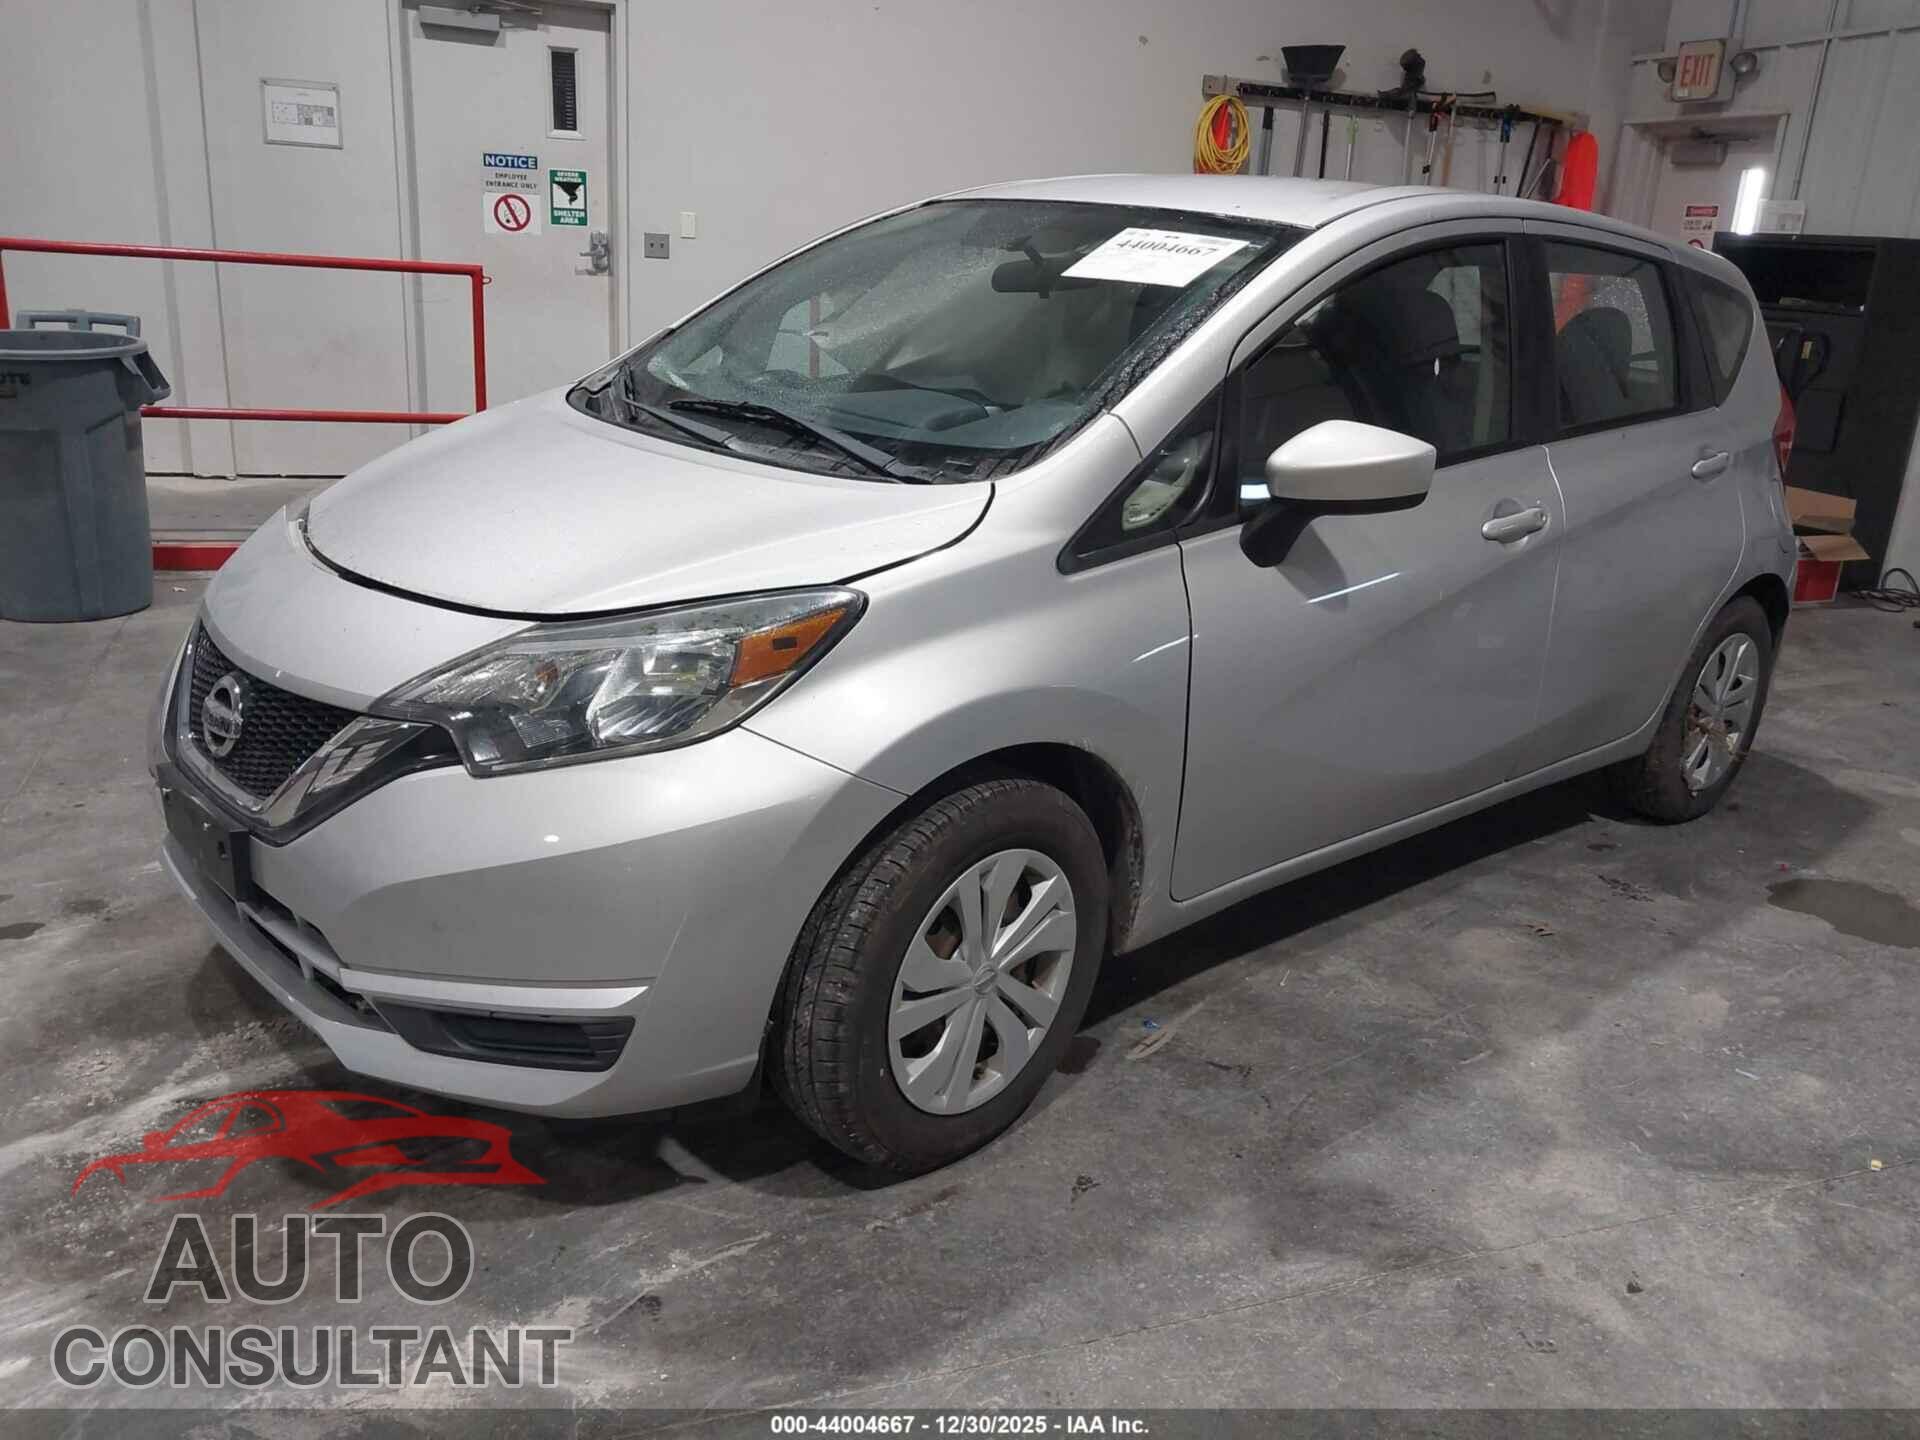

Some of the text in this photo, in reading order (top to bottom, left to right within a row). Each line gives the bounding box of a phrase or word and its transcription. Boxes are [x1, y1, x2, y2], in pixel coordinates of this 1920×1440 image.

[1680, 54, 1714, 88] EXIT
[485, 155, 536, 168] NOTICE
[495, 172, 528, 180] EMPLOYEE
[486, 180, 518, 188] ENTRANCE
[560, 216, 579, 224] AREA
[1116, 239, 1218, 255] 44004667
